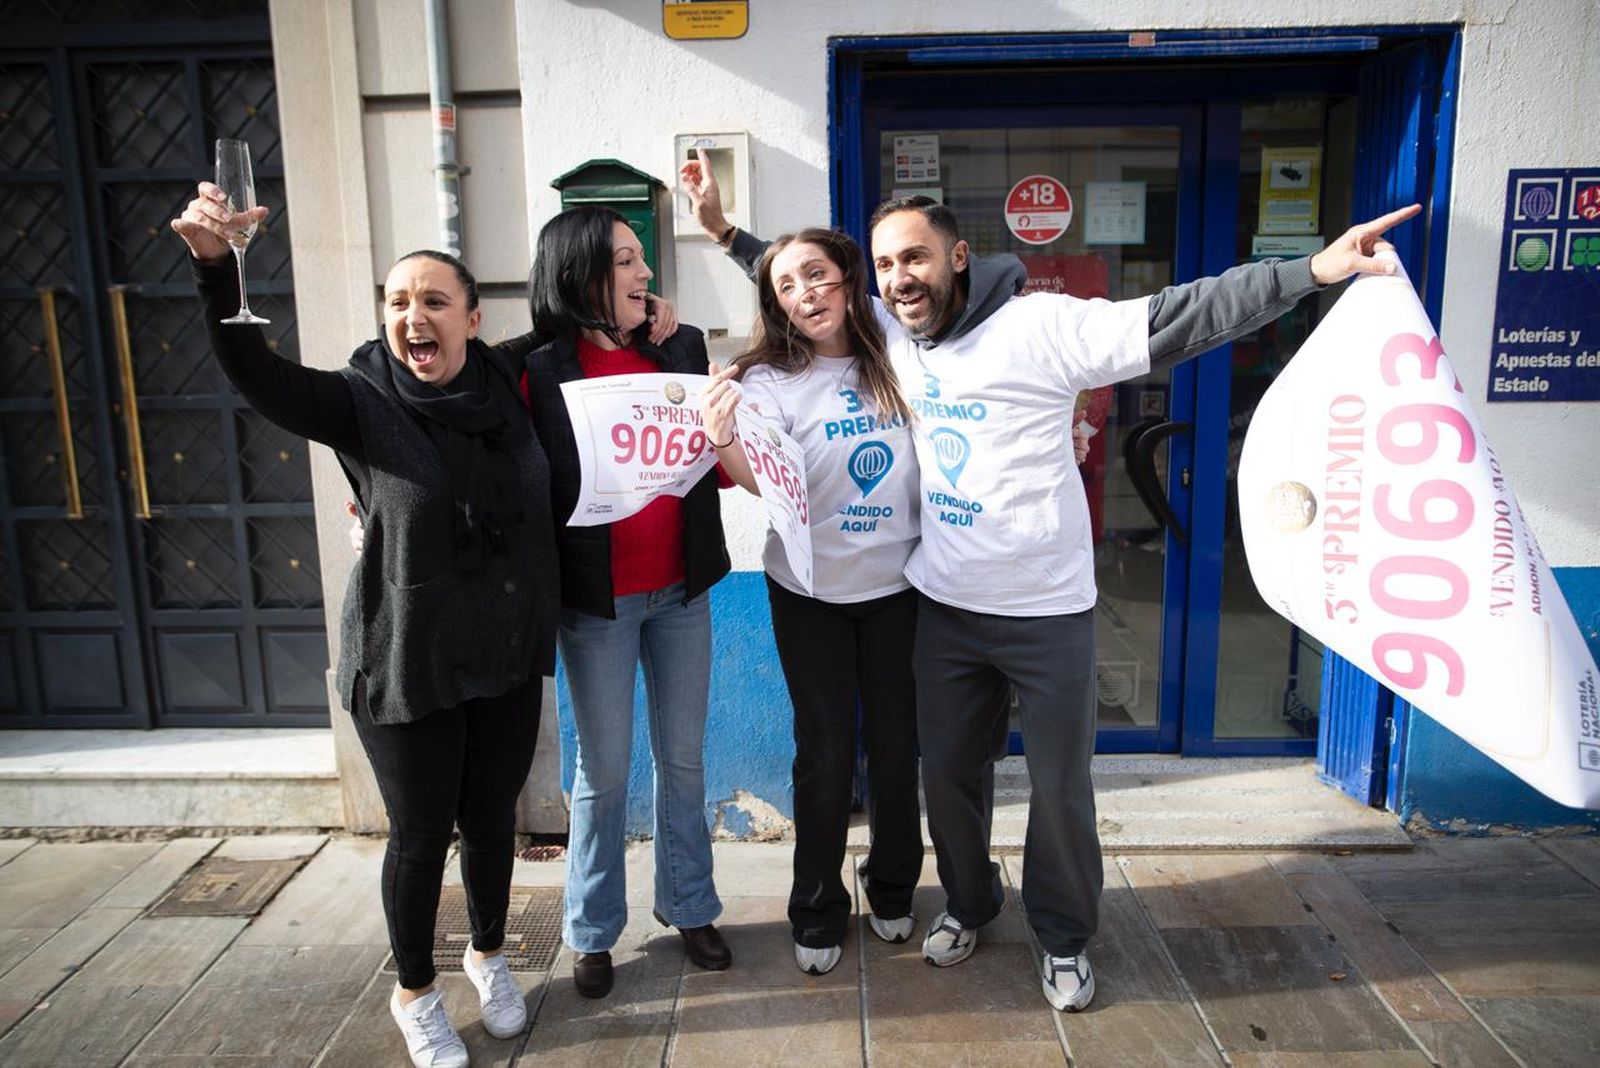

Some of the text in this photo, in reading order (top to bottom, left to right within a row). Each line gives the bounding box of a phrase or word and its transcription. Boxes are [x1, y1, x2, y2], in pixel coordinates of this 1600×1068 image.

[1018, 181, 1056, 206] +18
[1498, 326, 1581, 347] Loterías y
[1495, 350, 1600, 372] Apuestas del
[1493, 375, 1550, 393] Estado
[652, 404, 704, 427] PREMI
[909, 398, 988, 422] PREMIO
[611, 422, 714, 467] 9069
[743, 439, 808, 526] 90693
[1322, 393, 1367, 575] PREMIO
[839, 504, 894, 518] ENDIDO
[927, 490, 984, 514] VENDIDO
[840, 517, 878, 532] AQUÍ
[1368, 331, 1477, 698] 90693
[1489, 499, 1516, 618] VENDIDO
[1578, 679, 1591, 738] LOTERÍA
